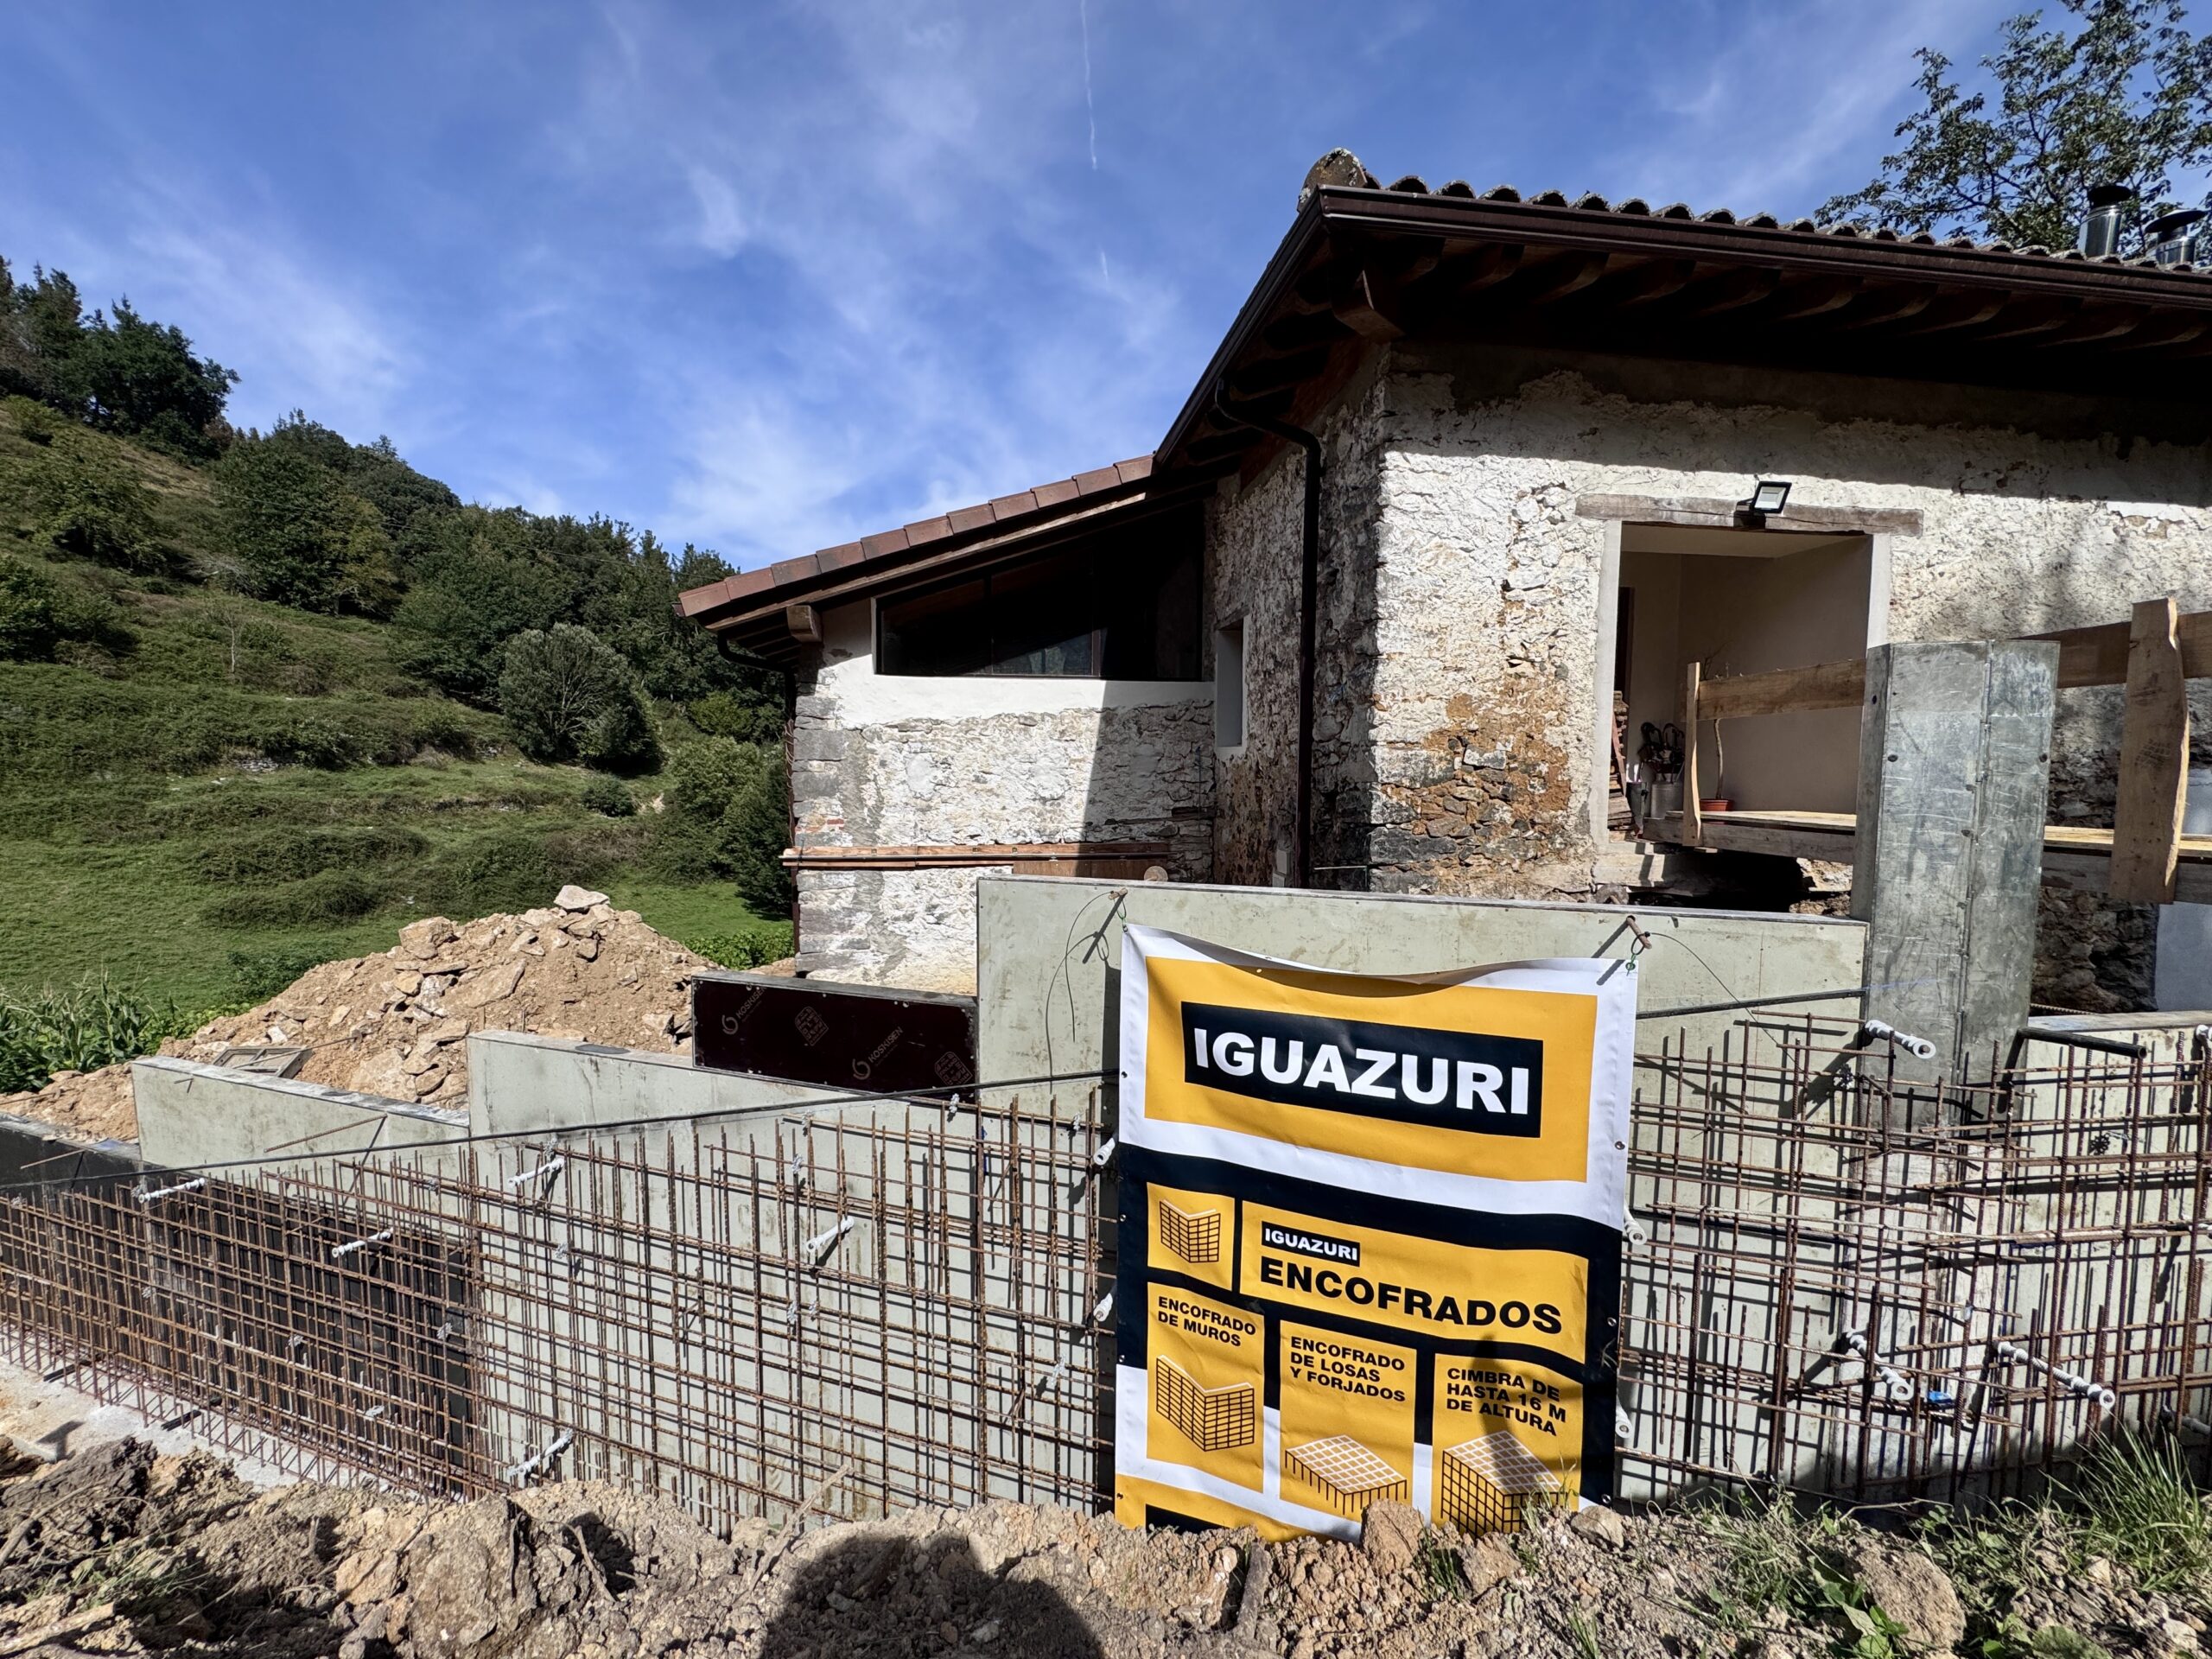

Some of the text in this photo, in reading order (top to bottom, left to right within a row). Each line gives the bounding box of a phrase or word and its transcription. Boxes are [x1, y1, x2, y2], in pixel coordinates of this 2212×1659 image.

[868, 1026, 904, 1063] KOSKISEN
[1193, 1028, 1529, 1115] IGUAZURI
[1264, 1228, 1357, 1261] IGUAZURI
[1260, 1255, 1562, 1334] ENCOFRADOS
[1158, 1296, 1256, 1335] ENCOFRADO
[1158, 1311, 1242, 1346] DE MUROS
[1290, 1351, 1381, 1382] DE LOSAS
[1291, 1336, 1405, 1371] ENCOFRADO
[1290, 1366, 1406, 1402] Y FORJADOS
[1447, 1368, 1560, 1402] CIMBRA DE
[1446, 1382, 1567, 1423] HASTA 16 M
[1446, 1398, 1557, 1436] DE ALTURA
